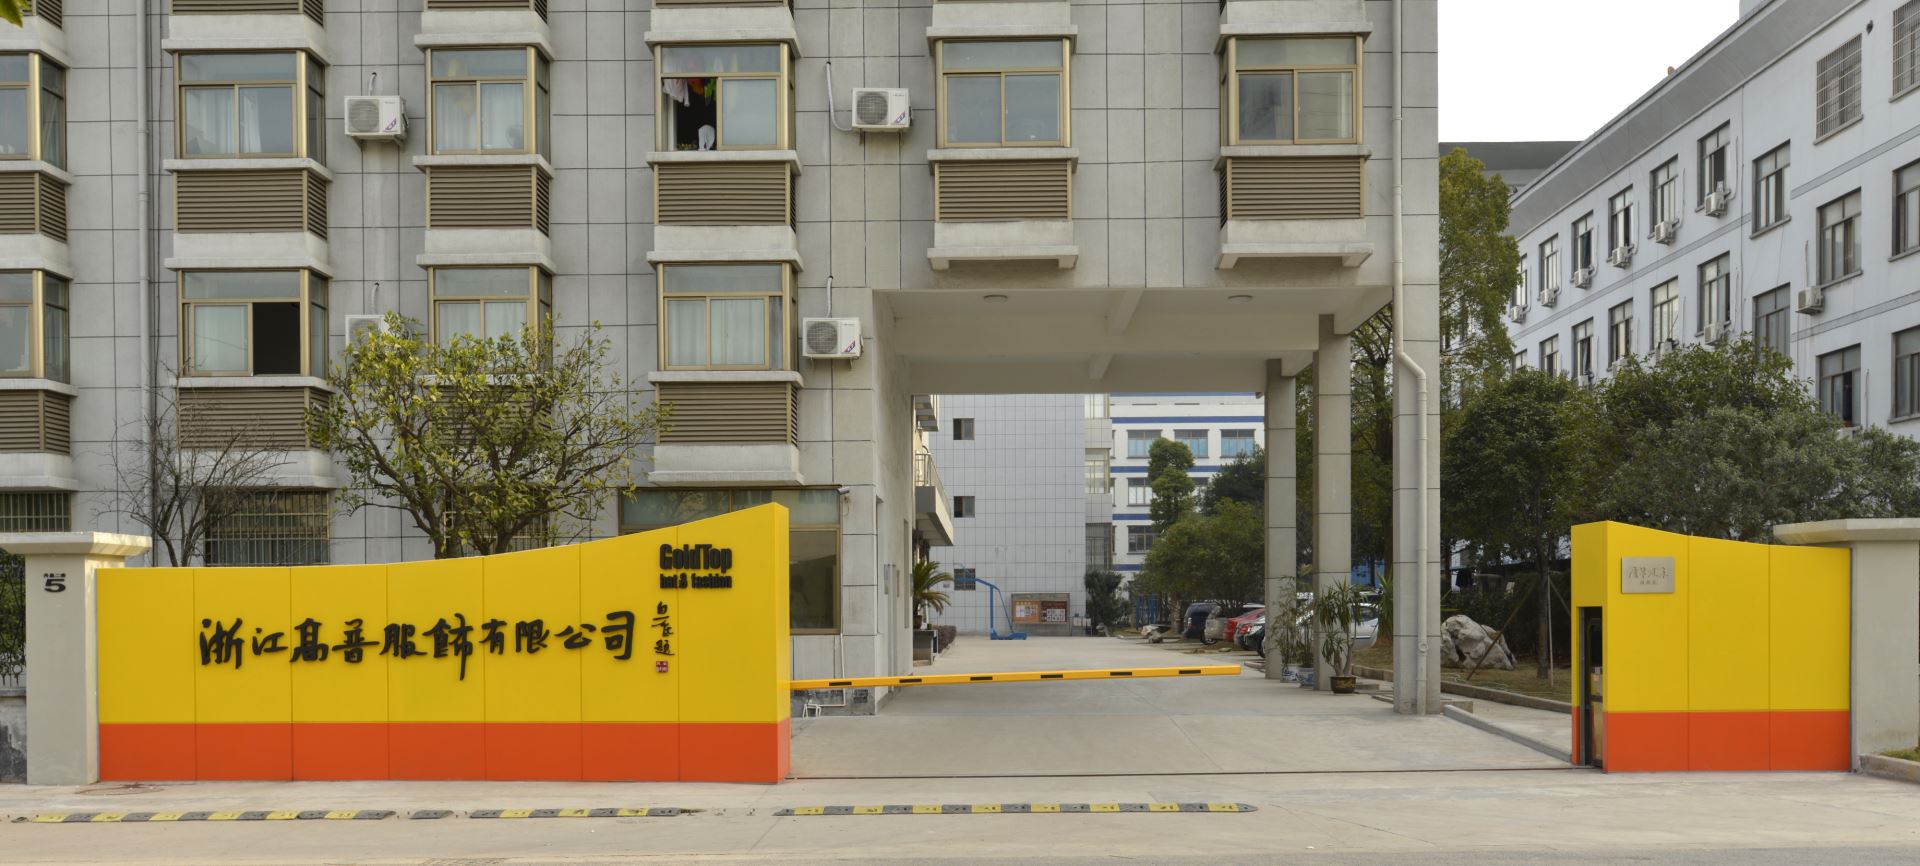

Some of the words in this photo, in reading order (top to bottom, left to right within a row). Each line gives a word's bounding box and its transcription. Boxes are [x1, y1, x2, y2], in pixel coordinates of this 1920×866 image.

[660, 543, 732, 573] GoldTop
[45, 579, 66, 593] 5
[691, 573, 732, 589] fashion
